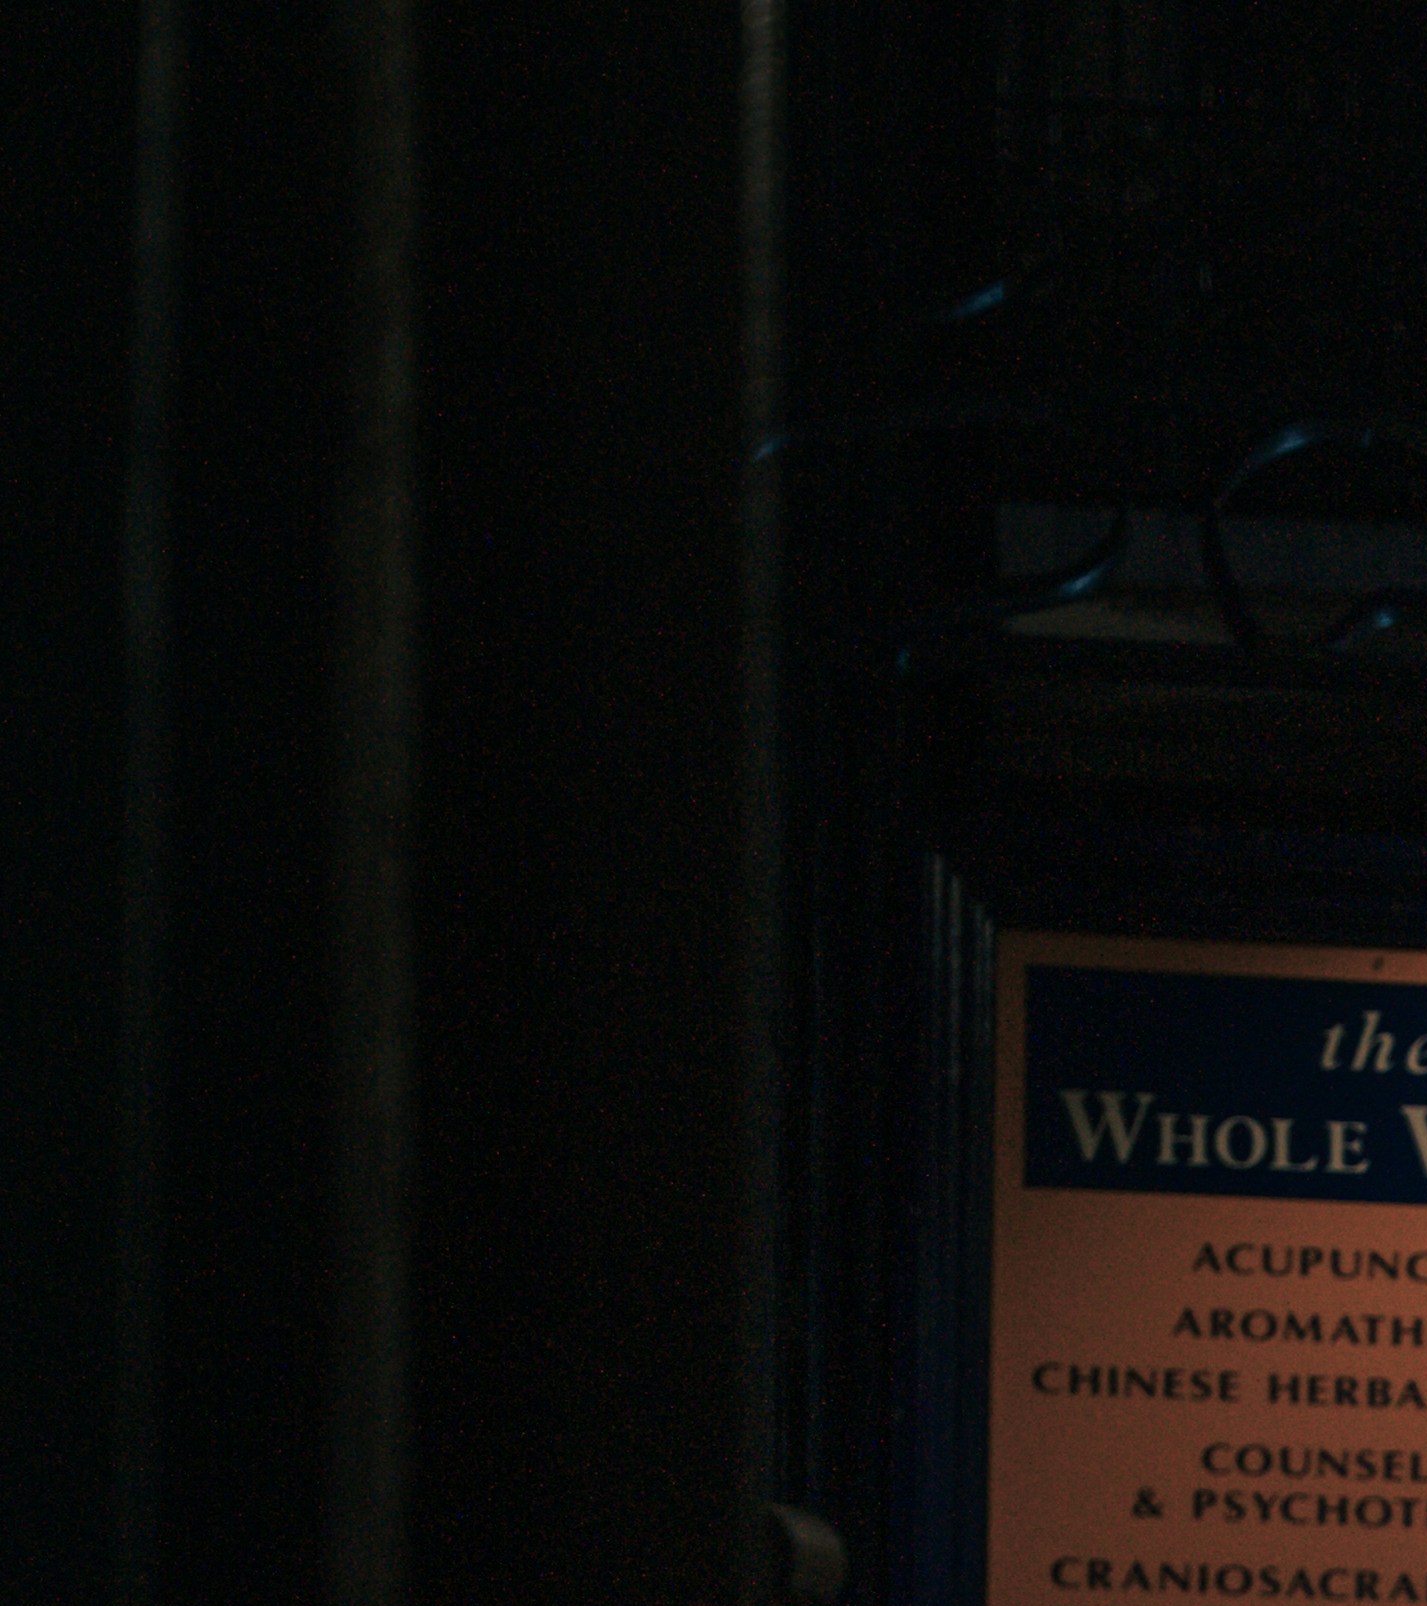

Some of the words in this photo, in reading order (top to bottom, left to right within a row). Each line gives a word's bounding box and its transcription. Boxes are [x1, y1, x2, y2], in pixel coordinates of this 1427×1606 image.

[1060, 1089, 1370, 1175] WHOLE
[1030, 1362, 1241, 1403] CHINESE
[1131, 1488, 1165, 1520] &
